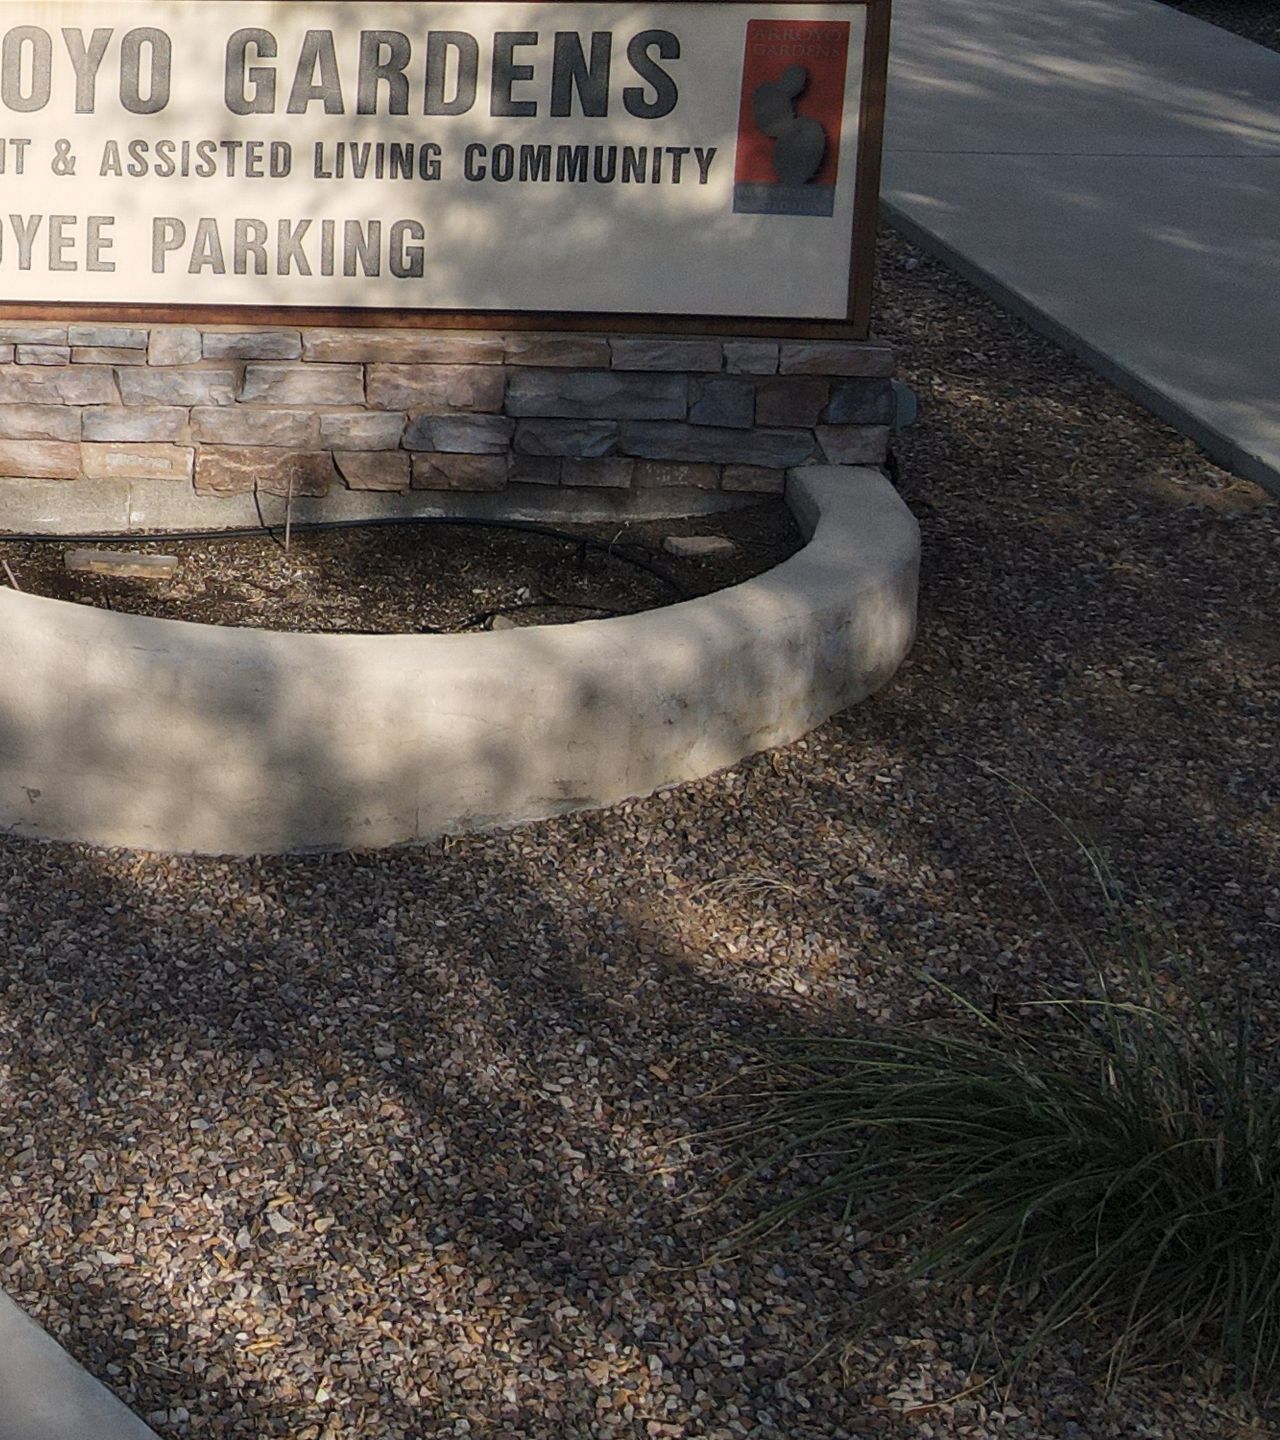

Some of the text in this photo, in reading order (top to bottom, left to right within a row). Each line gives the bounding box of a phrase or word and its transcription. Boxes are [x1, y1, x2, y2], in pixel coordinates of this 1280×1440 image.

[750, 43, 842, 59] GARDENS
[751, 26, 843, 43] ARROYO
[224, 27, 681, 120] GARDENS
[51, 138, 76, 177] &
[99, 139, 292, 178] ASSISTED
[313, 141, 442, 181] LIVING
[463, 142, 718, 185] COMMUNITY
[151, 216, 425, 279] PARKING
